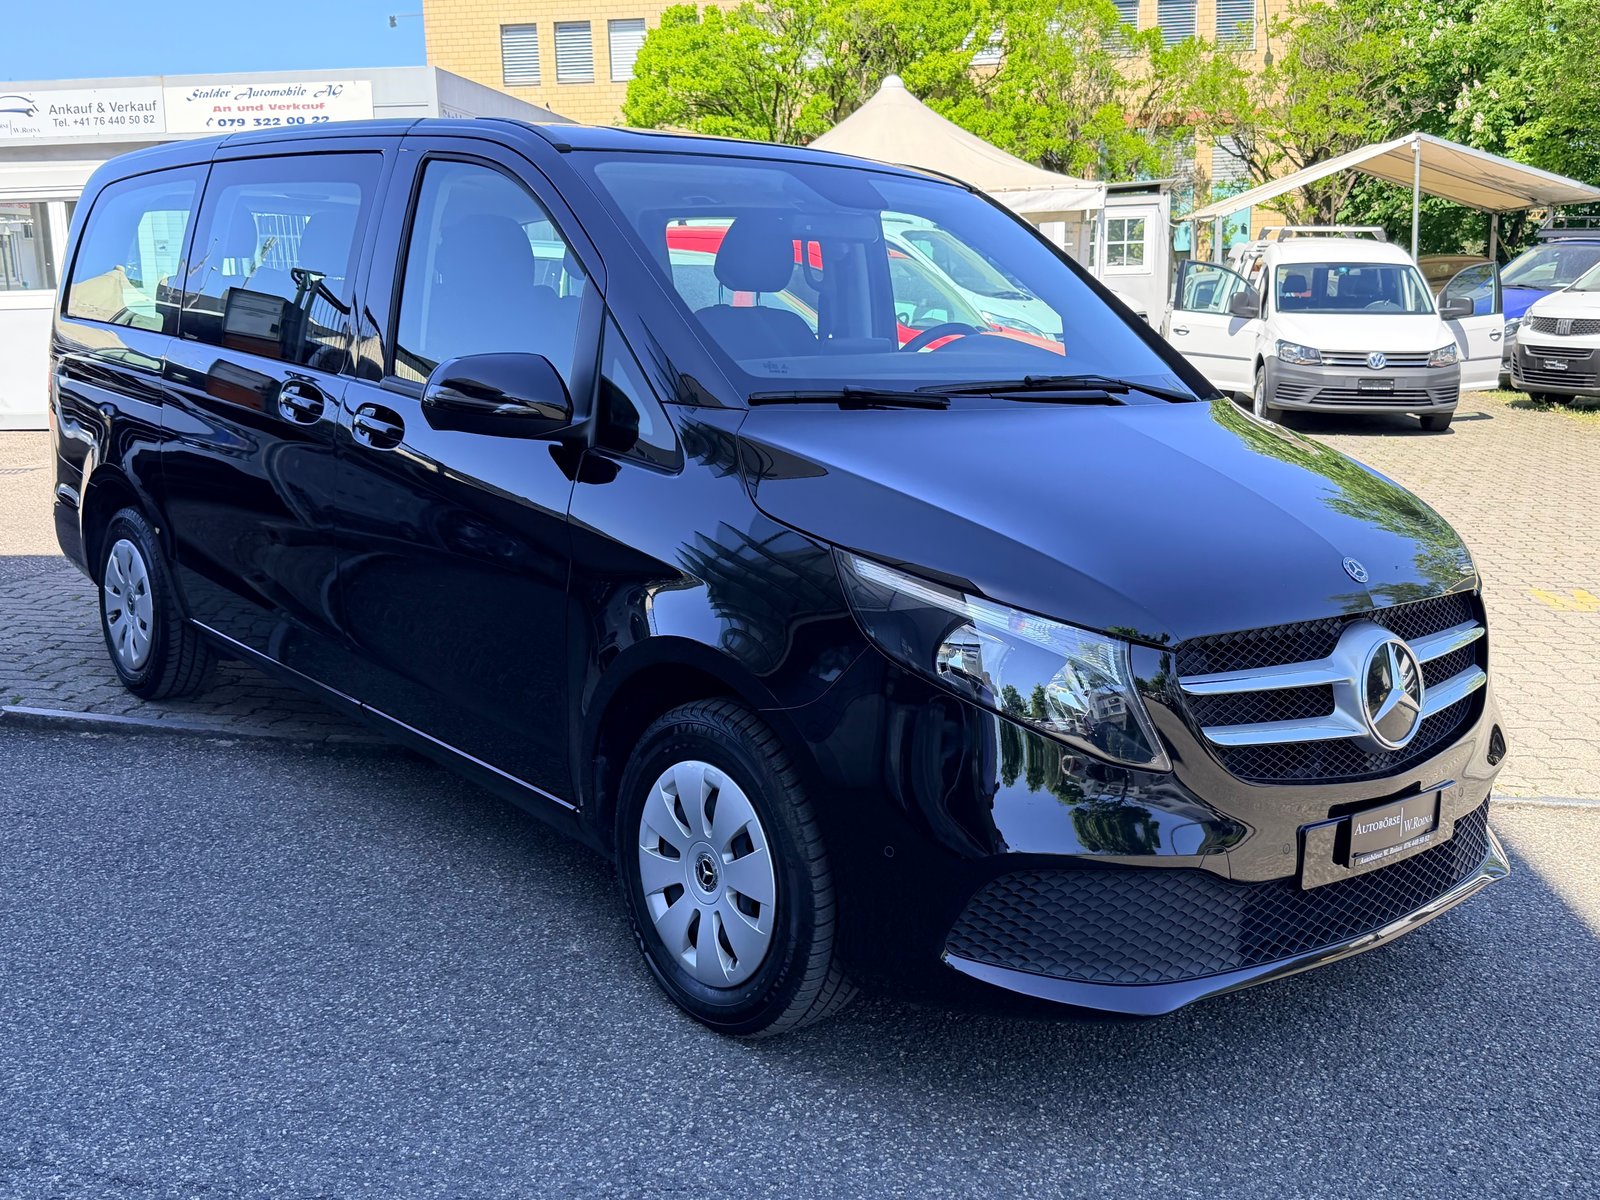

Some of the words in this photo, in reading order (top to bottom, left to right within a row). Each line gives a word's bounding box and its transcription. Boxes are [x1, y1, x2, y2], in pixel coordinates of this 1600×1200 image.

[186, 88, 231, 102] Stalder
[234, 86, 307, 101] Automobile
[313, 84, 344, 98] AG
[49, 102, 93, 115] Ankauf
[96, 102, 106, 113] &
[109, 100, 157, 113] Verkauf
[212, 105, 232, 113] An
[237, 104, 264, 112] und
[268, 102, 326, 111] Verkauf
[53, 118, 70, 128] Tel.
[73, 117, 90, 126] +41
[93, 116, 106, 126] 76
[108, 115, 126, 125] 440
[128, 115, 141, 124] 50
[143, 114, 156, 124] 82
[217, 118, 246, 127] 079
[253, 117, 281, 126] 322
[286, 116, 305, 125] 00
[1555, 318, 1574, 335] FIAT
